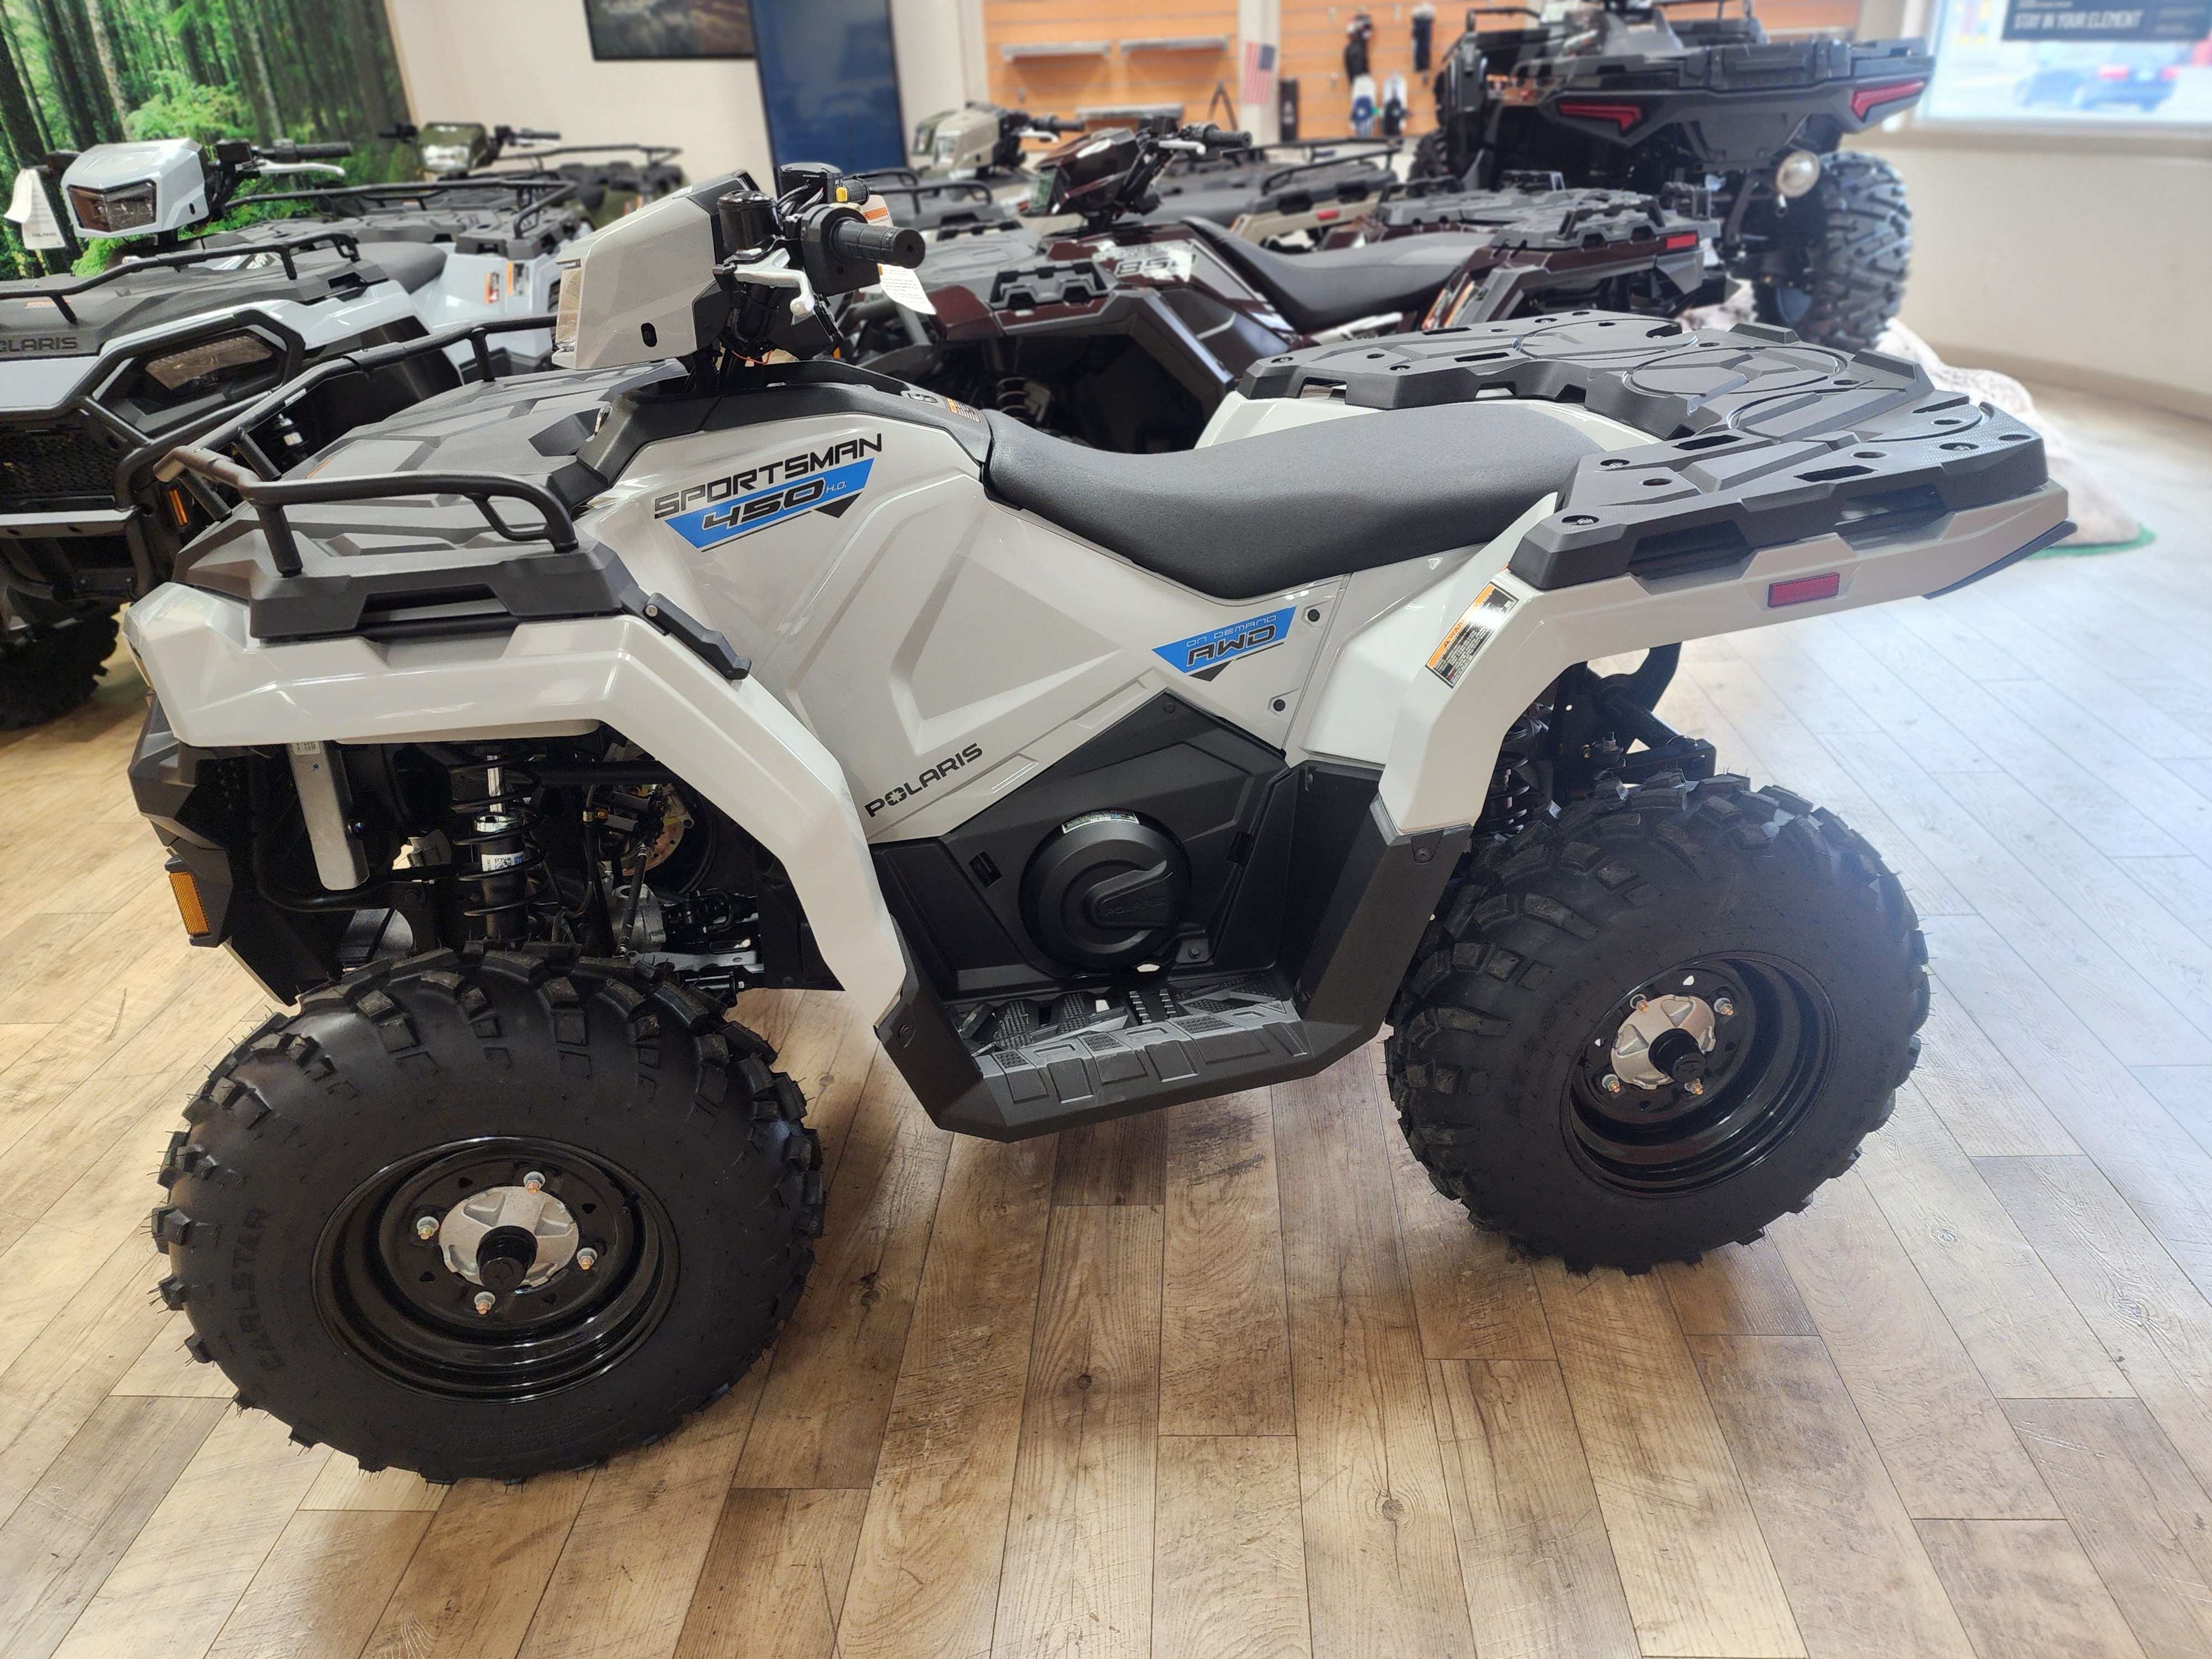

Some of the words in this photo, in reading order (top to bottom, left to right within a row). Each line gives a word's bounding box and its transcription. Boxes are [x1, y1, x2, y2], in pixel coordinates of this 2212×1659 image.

[654, 432, 882, 520] SPORTSMAN
[702, 477, 826, 530] 450
[826, 479, 848, 494] H.O.
[1186, 624, 1276, 667] AWD
[1214, 614, 1277, 638] DEMAND
[864, 742, 983, 818] POLARIS
[1105, 897, 1164, 916] POLARIS
